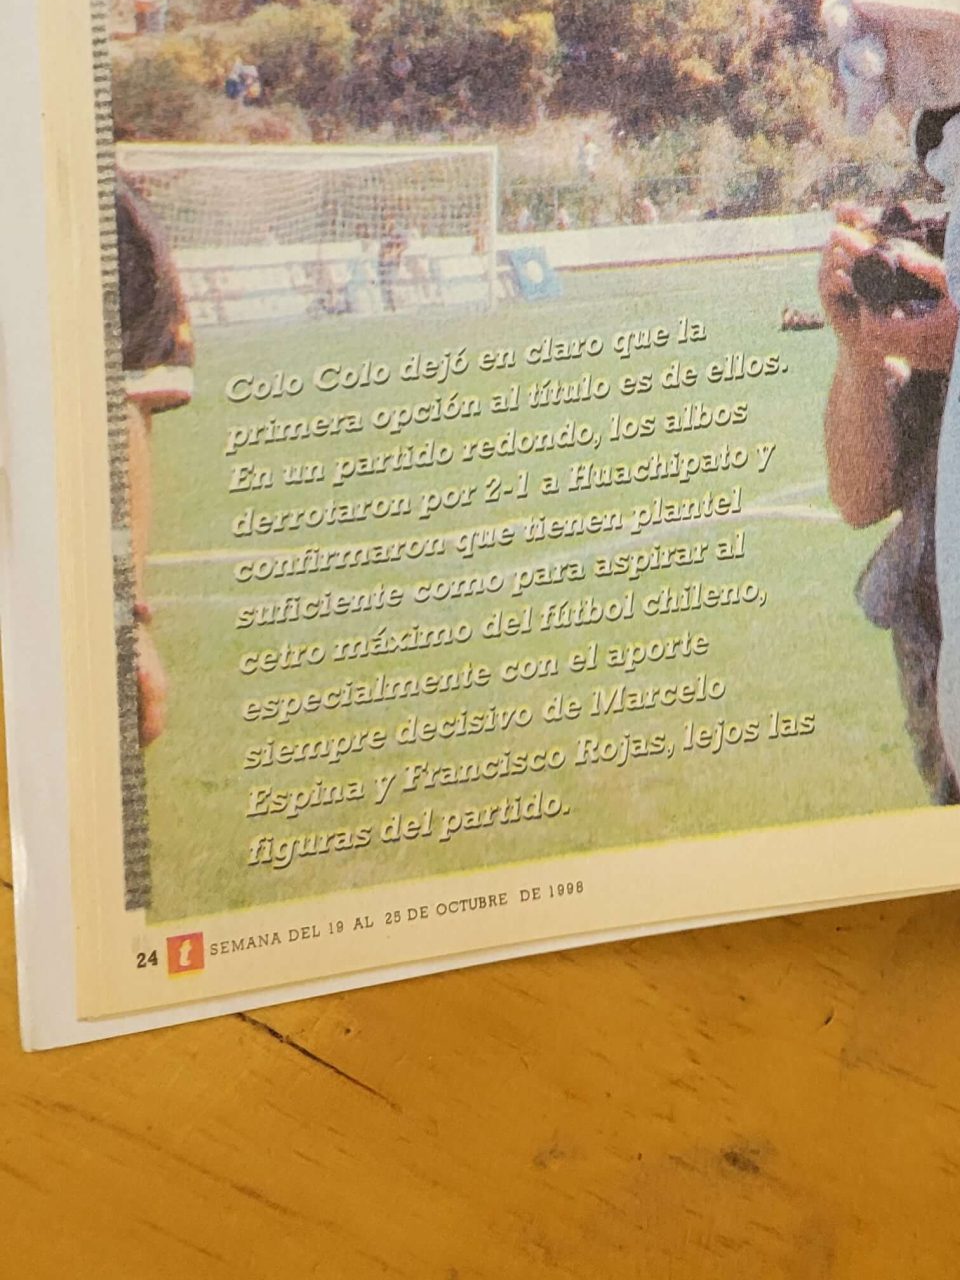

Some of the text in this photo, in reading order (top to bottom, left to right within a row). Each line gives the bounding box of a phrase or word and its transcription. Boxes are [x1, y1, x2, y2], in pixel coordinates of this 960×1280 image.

[224, 316, 707, 402] Colo Colo dejó en claro que la
[225, 352, 788, 456] primera opción al título es de ellos.
[229, 401, 748, 493] En un partido redondo, los albos
[232, 442, 776, 538] derrotaron por 2-1 a Huachipato y
[234, 485, 742, 582] confirmaron que tienen plantel
[236, 529, 745, 629] suficiente como para aspirar al
[239, 580, 768, 675] cetro máximo del fútbol chileno,
[242, 631, 710, 724] especialmente con el aporte
[243, 673, 726, 770] siempre decisivo de Marcelo
[246, 710, 816, 818] Espina y Francisco Rojas, lejos las
[247, 789, 571, 870] figuras del partido.
[136, 950, 158, 969] 24
[210, 881, 584, 956] SEMANA DEL 19 AL 25 DE OCTUBRE DE 1998
